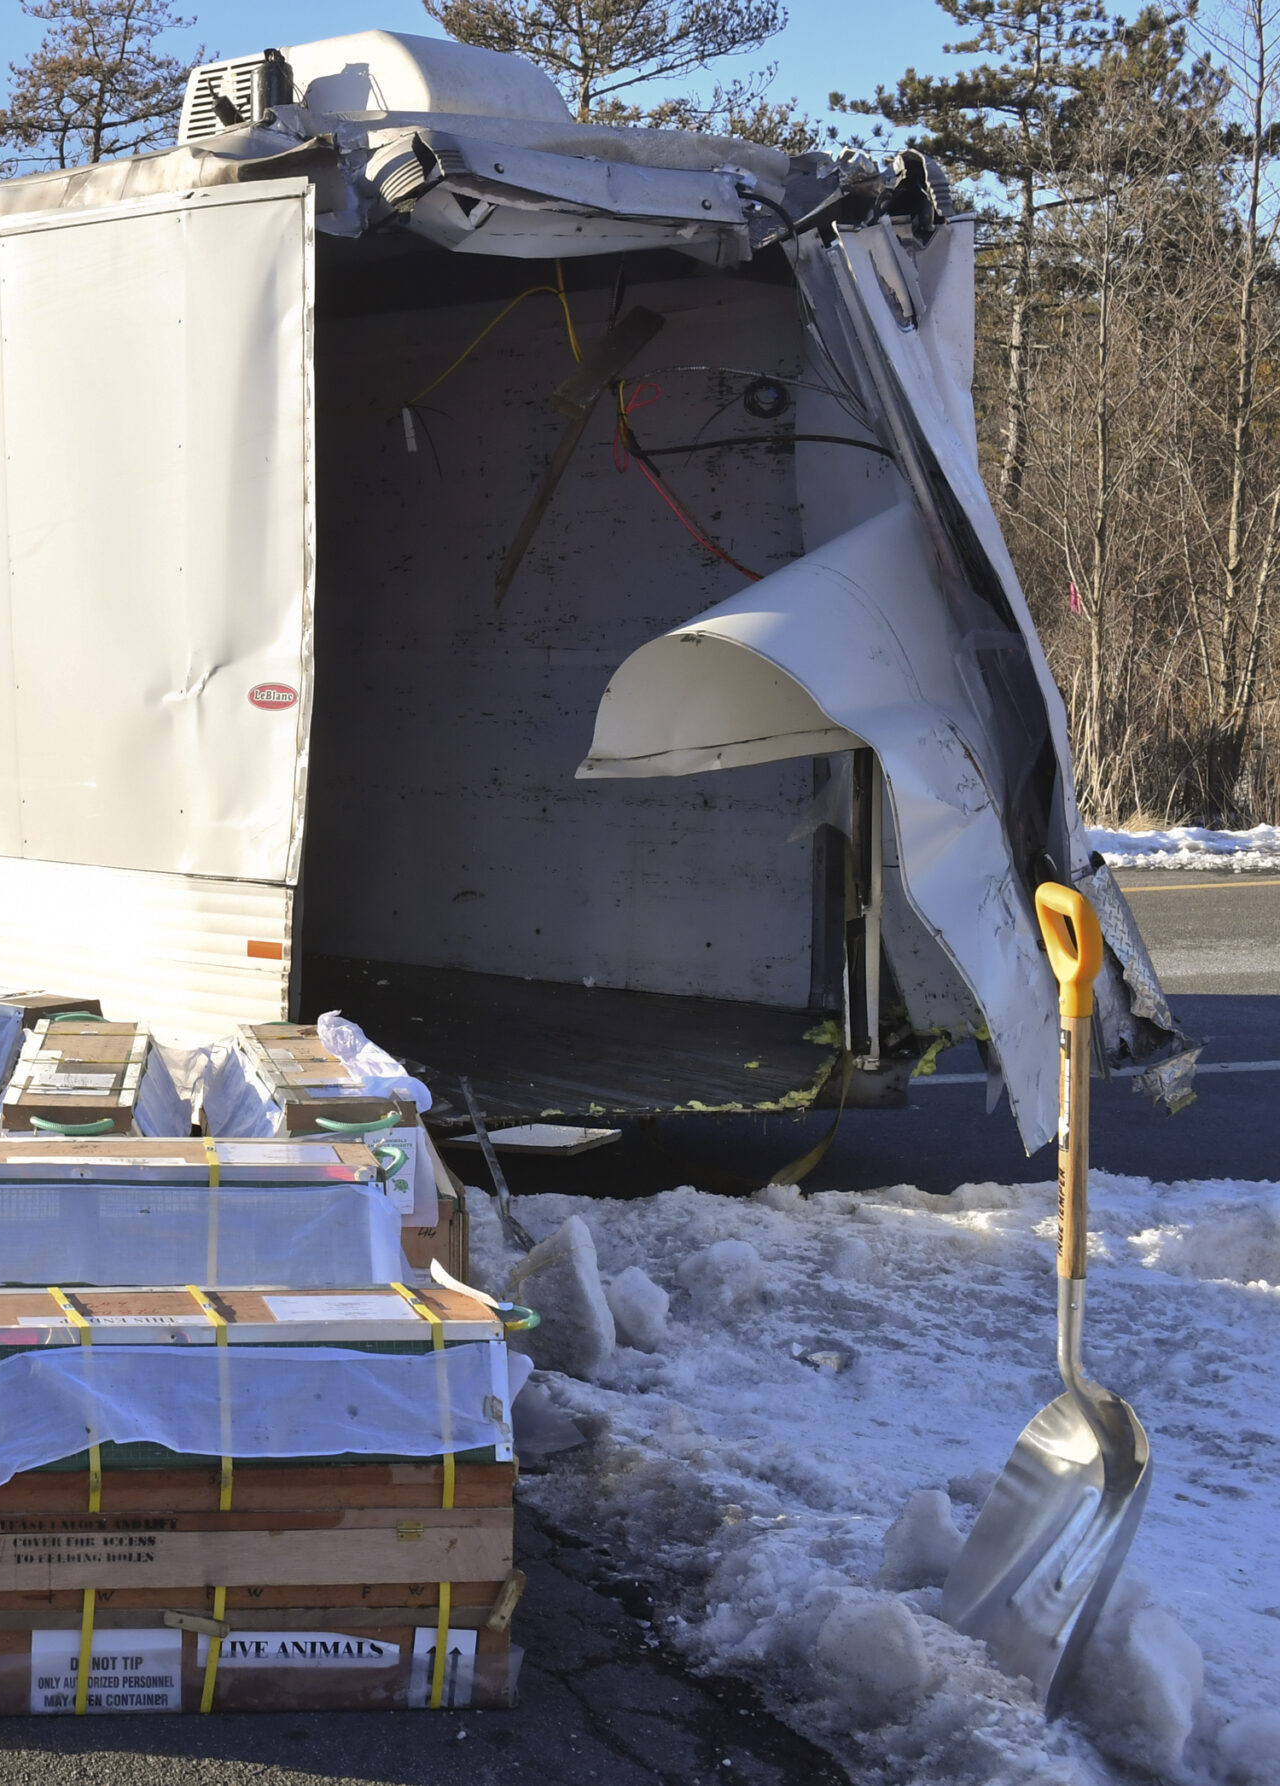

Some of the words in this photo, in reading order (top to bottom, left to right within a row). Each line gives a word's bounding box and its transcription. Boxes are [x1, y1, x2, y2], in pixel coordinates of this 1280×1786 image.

[254, 690, 293, 701] LeBlanc
[12, 1536, 62, 1548] COVER
[65, 1536, 96, 1548] FOR
[103, 1535, 157, 1547] ACCESS
[14, 1553, 34, 1565] TO
[219, 1640, 269, 1659] LIVE
[275, 1640, 384, 1659] ANIMALS
[92, 1656, 118, 1671] NOT
[122, 1656, 144, 1671] TIP
[38, 1676, 61, 1690] ONLY
[64, 1676, 119, 1690] AUORIZED
[122, 1675, 175, 1689] PERSONNEL
[44, 1694, 69, 1708] MAY
[106, 1693, 169, 1707] CONTAINER
